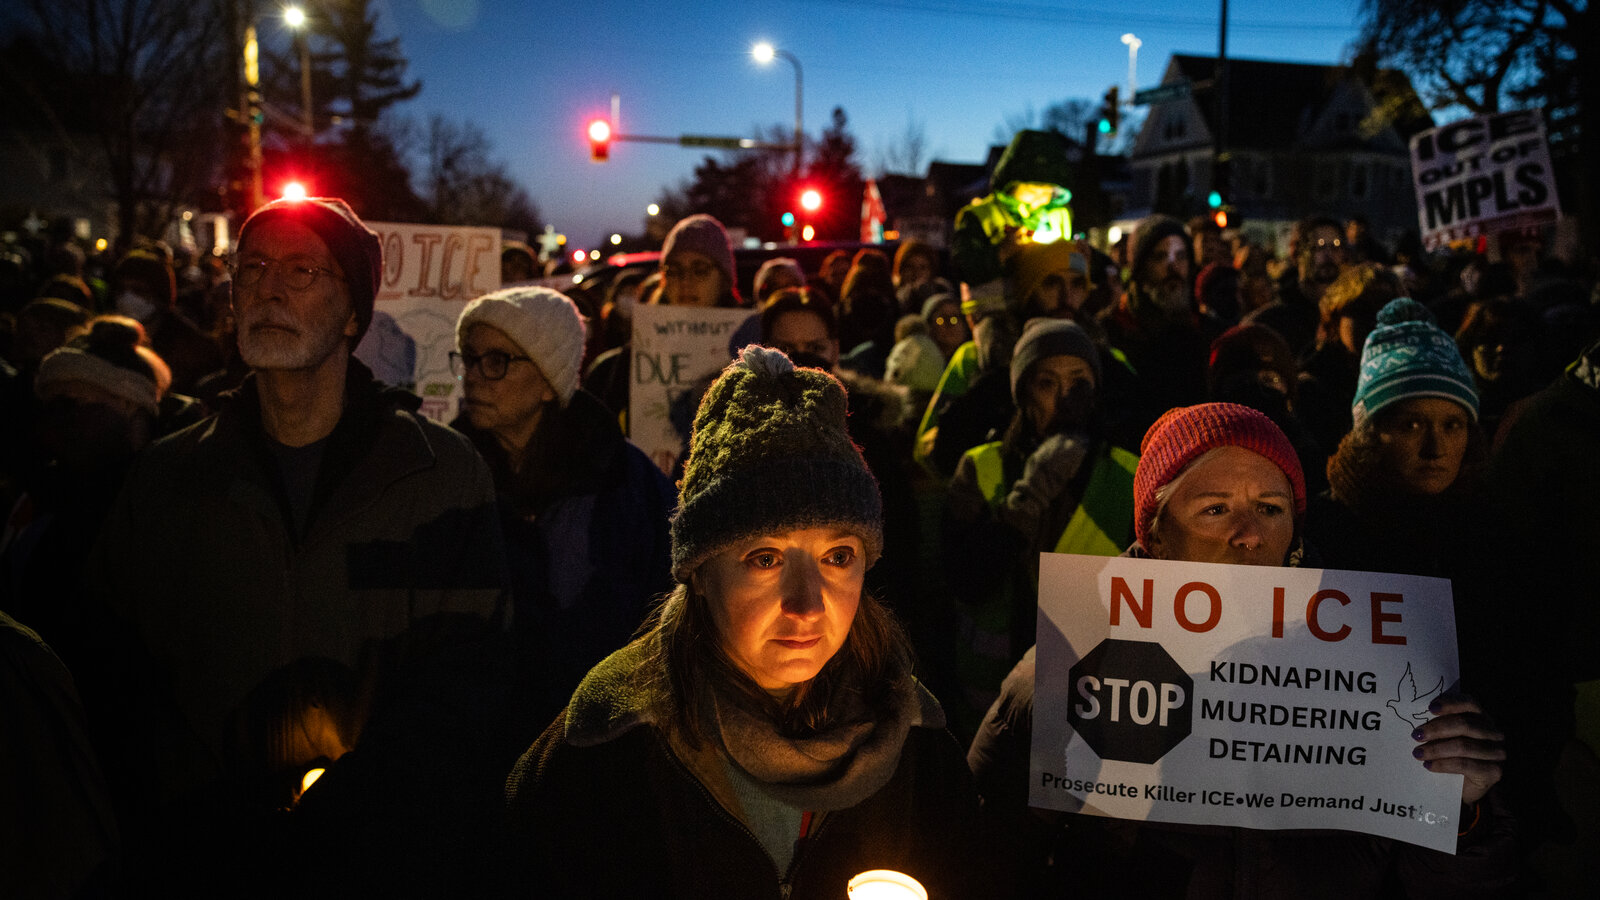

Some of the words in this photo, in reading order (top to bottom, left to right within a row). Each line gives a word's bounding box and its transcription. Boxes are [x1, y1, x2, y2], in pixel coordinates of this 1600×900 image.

[1420, 111, 1537, 160] ICE
[1421, 152, 1486, 185] OUT
[1492, 138, 1541, 163] OF
[1425, 163, 1548, 229] MPLS
[378, 231, 404, 288] O
[407, 233, 493, 300] ICE
[636, 351, 691, 386] DUE
[1109, 576, 1223, 633] NO
[1271, 586, 1408, 646] ICE
[1075, 674, 1186, 727] STOP
[1210, 661, 1377, 693] KIDNAPING
[1201, 698, 1382, 731] MURDERING
[1209, 738, 1367, 766] DETAINING
[1042, 772, 1138, 798] Prosecute
[1145, 784, 1196, 803] Killer
[1280, 793, 1364, 810] Demand
